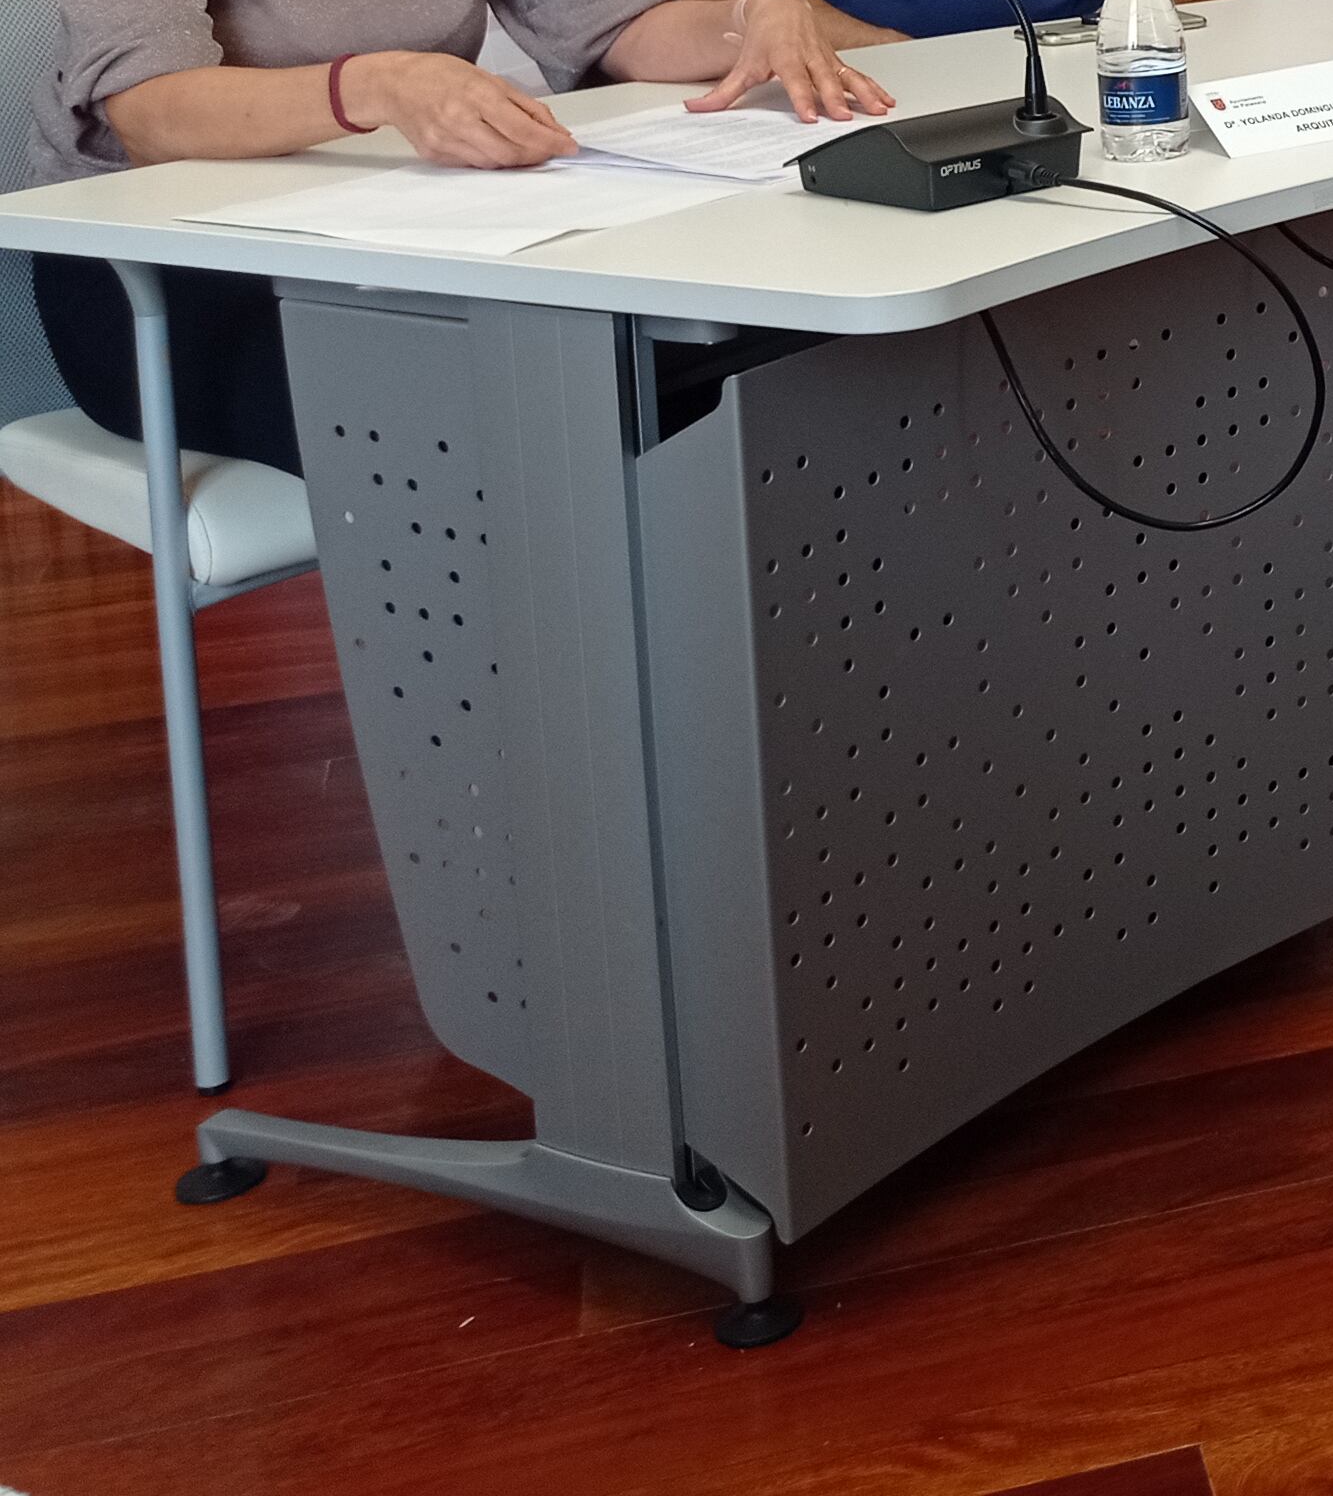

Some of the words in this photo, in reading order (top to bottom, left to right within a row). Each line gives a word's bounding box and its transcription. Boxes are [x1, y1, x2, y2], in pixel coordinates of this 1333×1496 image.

[1103, 95, 1156, 110] LEBANZA
[1240, 111, 1290, 126] YOLANDA
[940, 158, 982, 177] OPTIMUS
